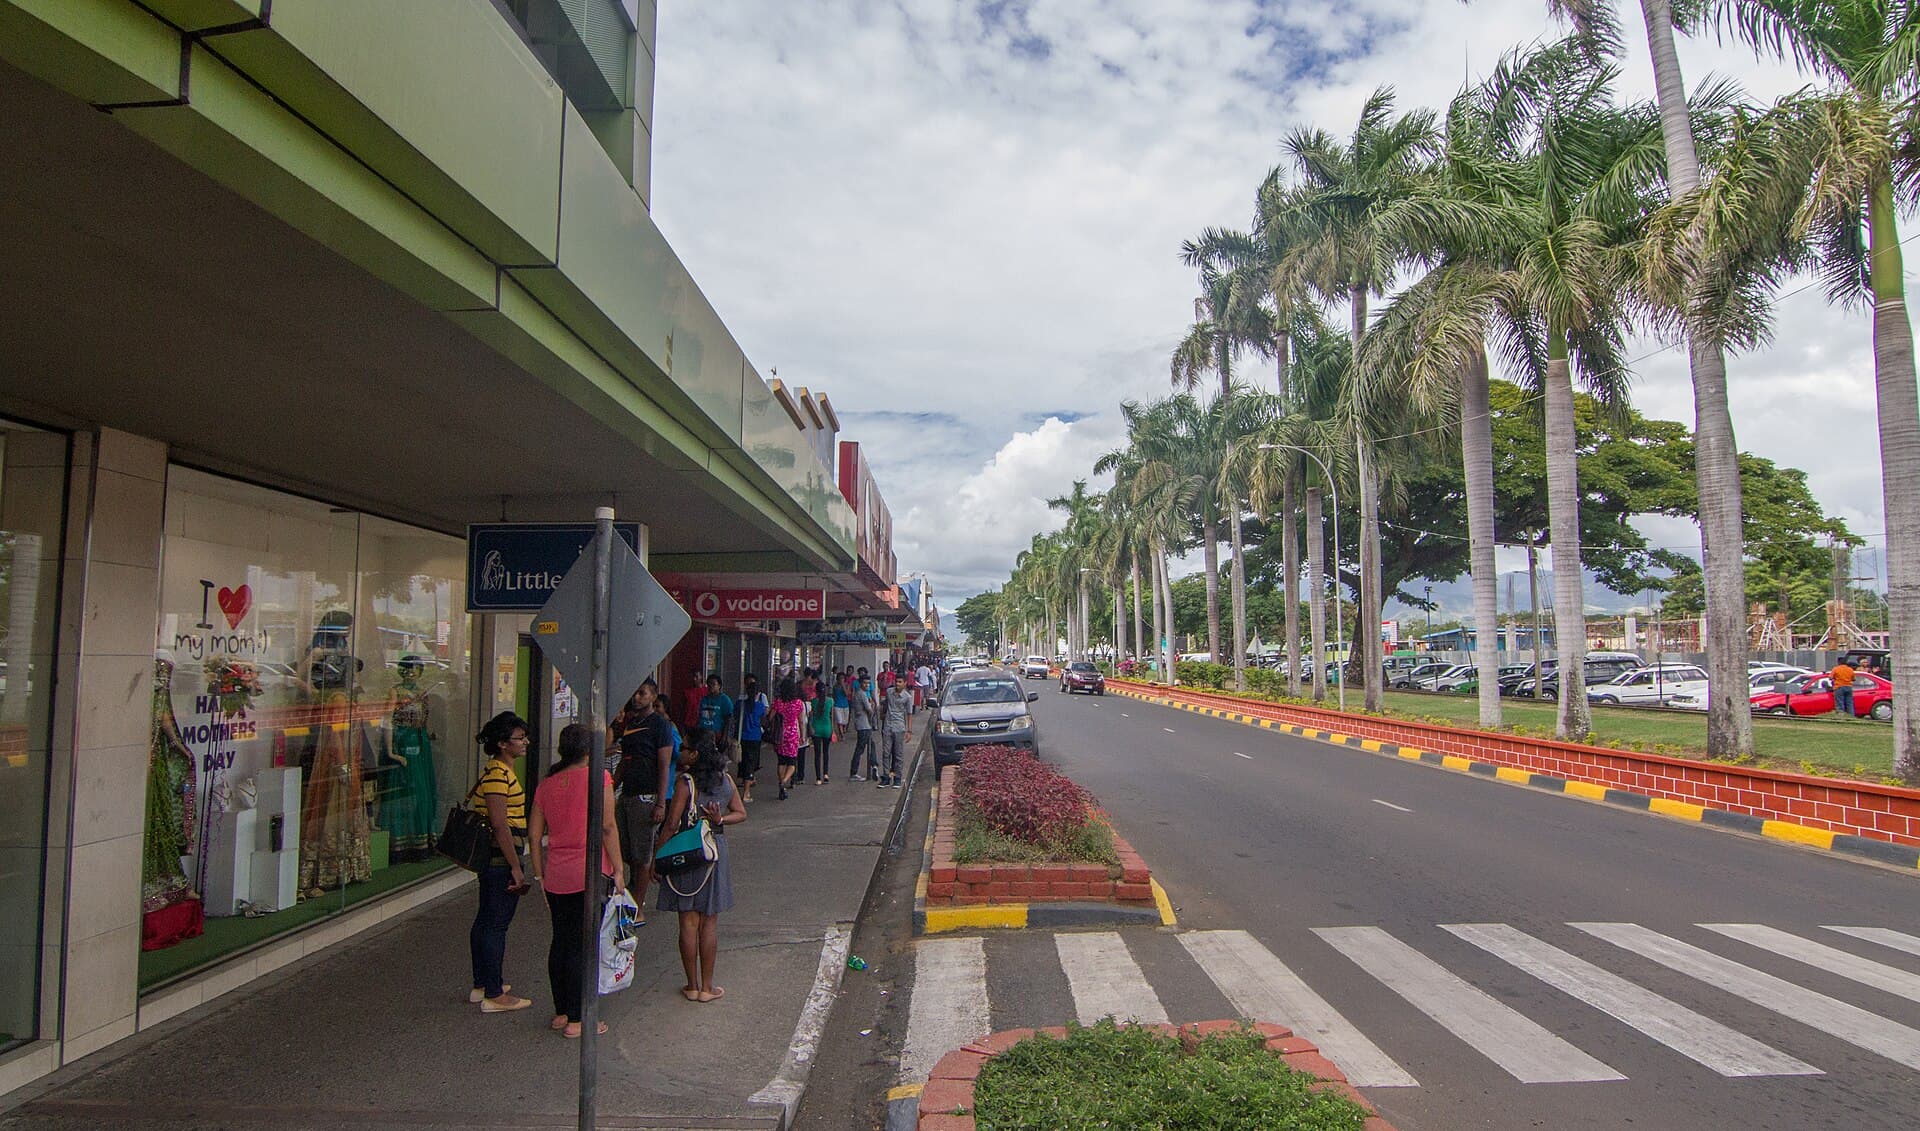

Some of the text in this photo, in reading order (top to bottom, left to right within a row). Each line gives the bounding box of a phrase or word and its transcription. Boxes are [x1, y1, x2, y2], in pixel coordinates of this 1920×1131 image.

[506, 571, 562, 590] Little
[196, 579, 215, 629] I
[726, 595, 818, 611] vodafone
[175, 634, 204, 660] my
[183, 721, 256, 745] MOTHERS
[203, 751, 236, 772] DAY
